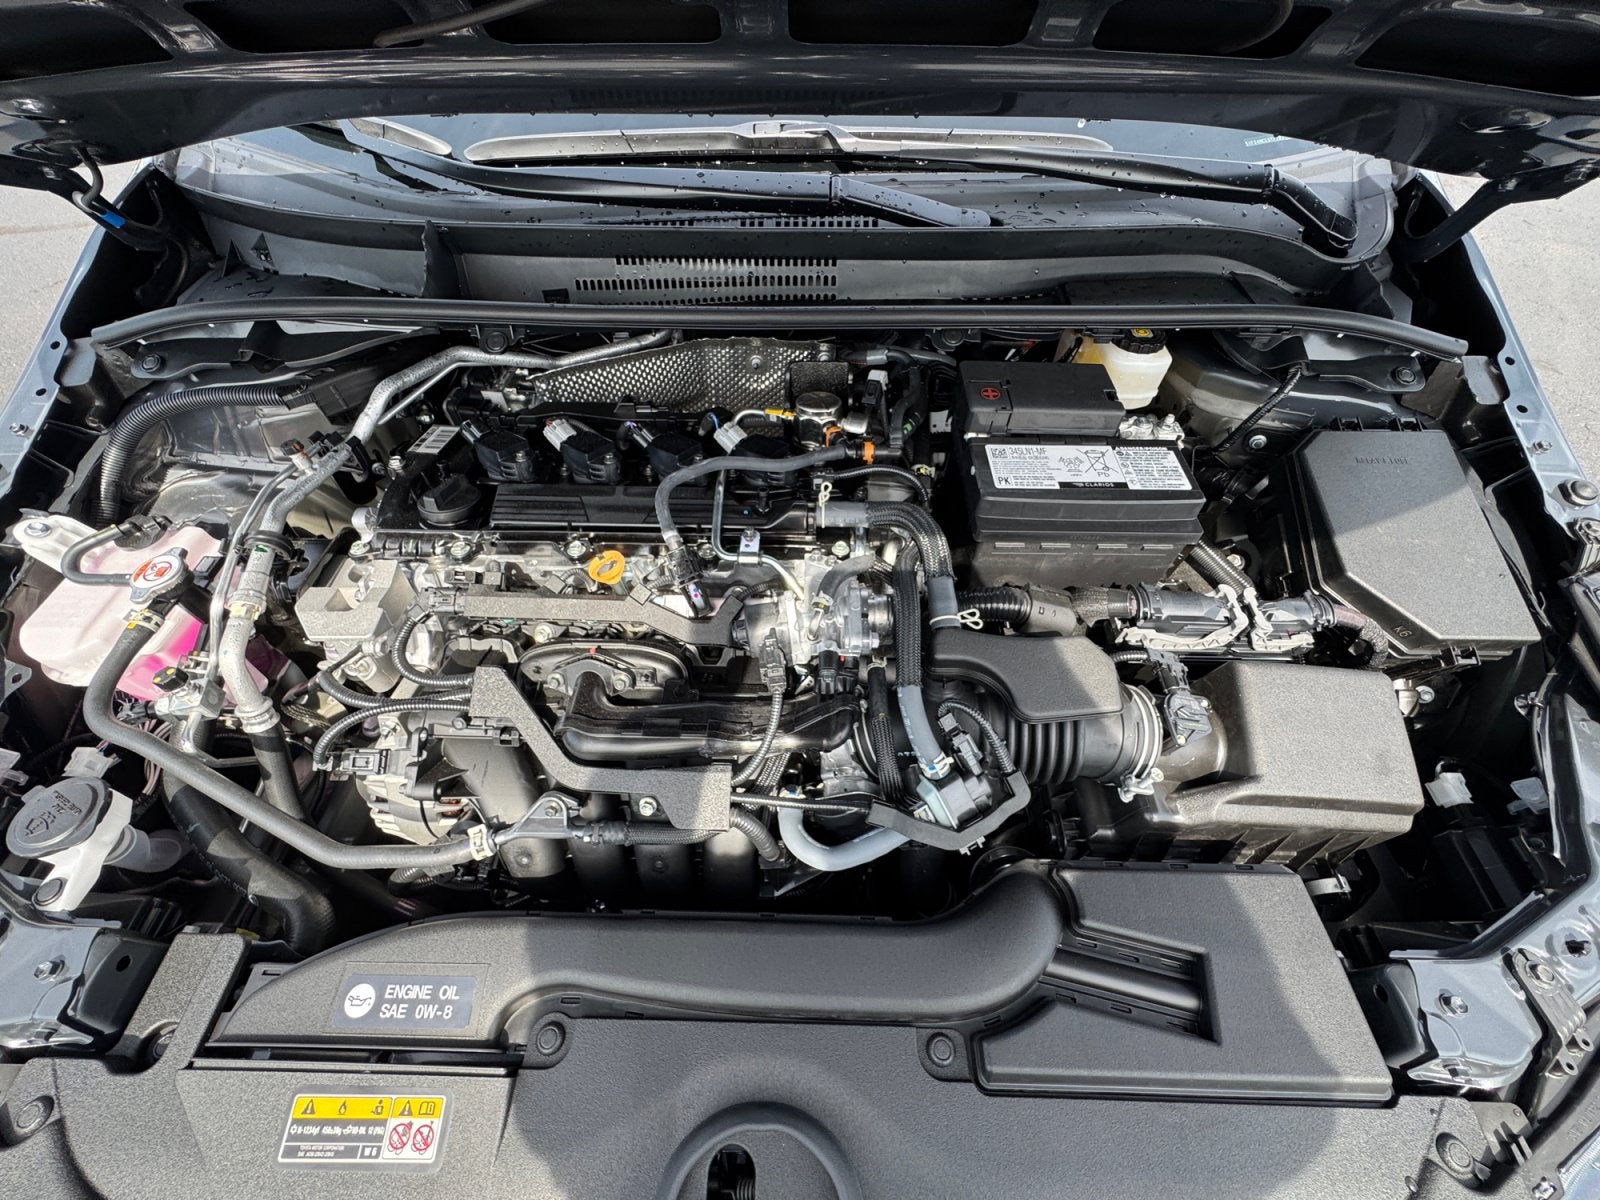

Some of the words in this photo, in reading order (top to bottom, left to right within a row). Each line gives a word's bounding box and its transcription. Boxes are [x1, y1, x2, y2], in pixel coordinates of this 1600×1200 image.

[997, 476, 1011, 485] PK
[384, 984, 433, 1000] ENGINE
[439, 985, 460, 1001] OIL
[379, 1003, 409, 1018] SAE
[415, 1004, 453, 1020] 0W-8
